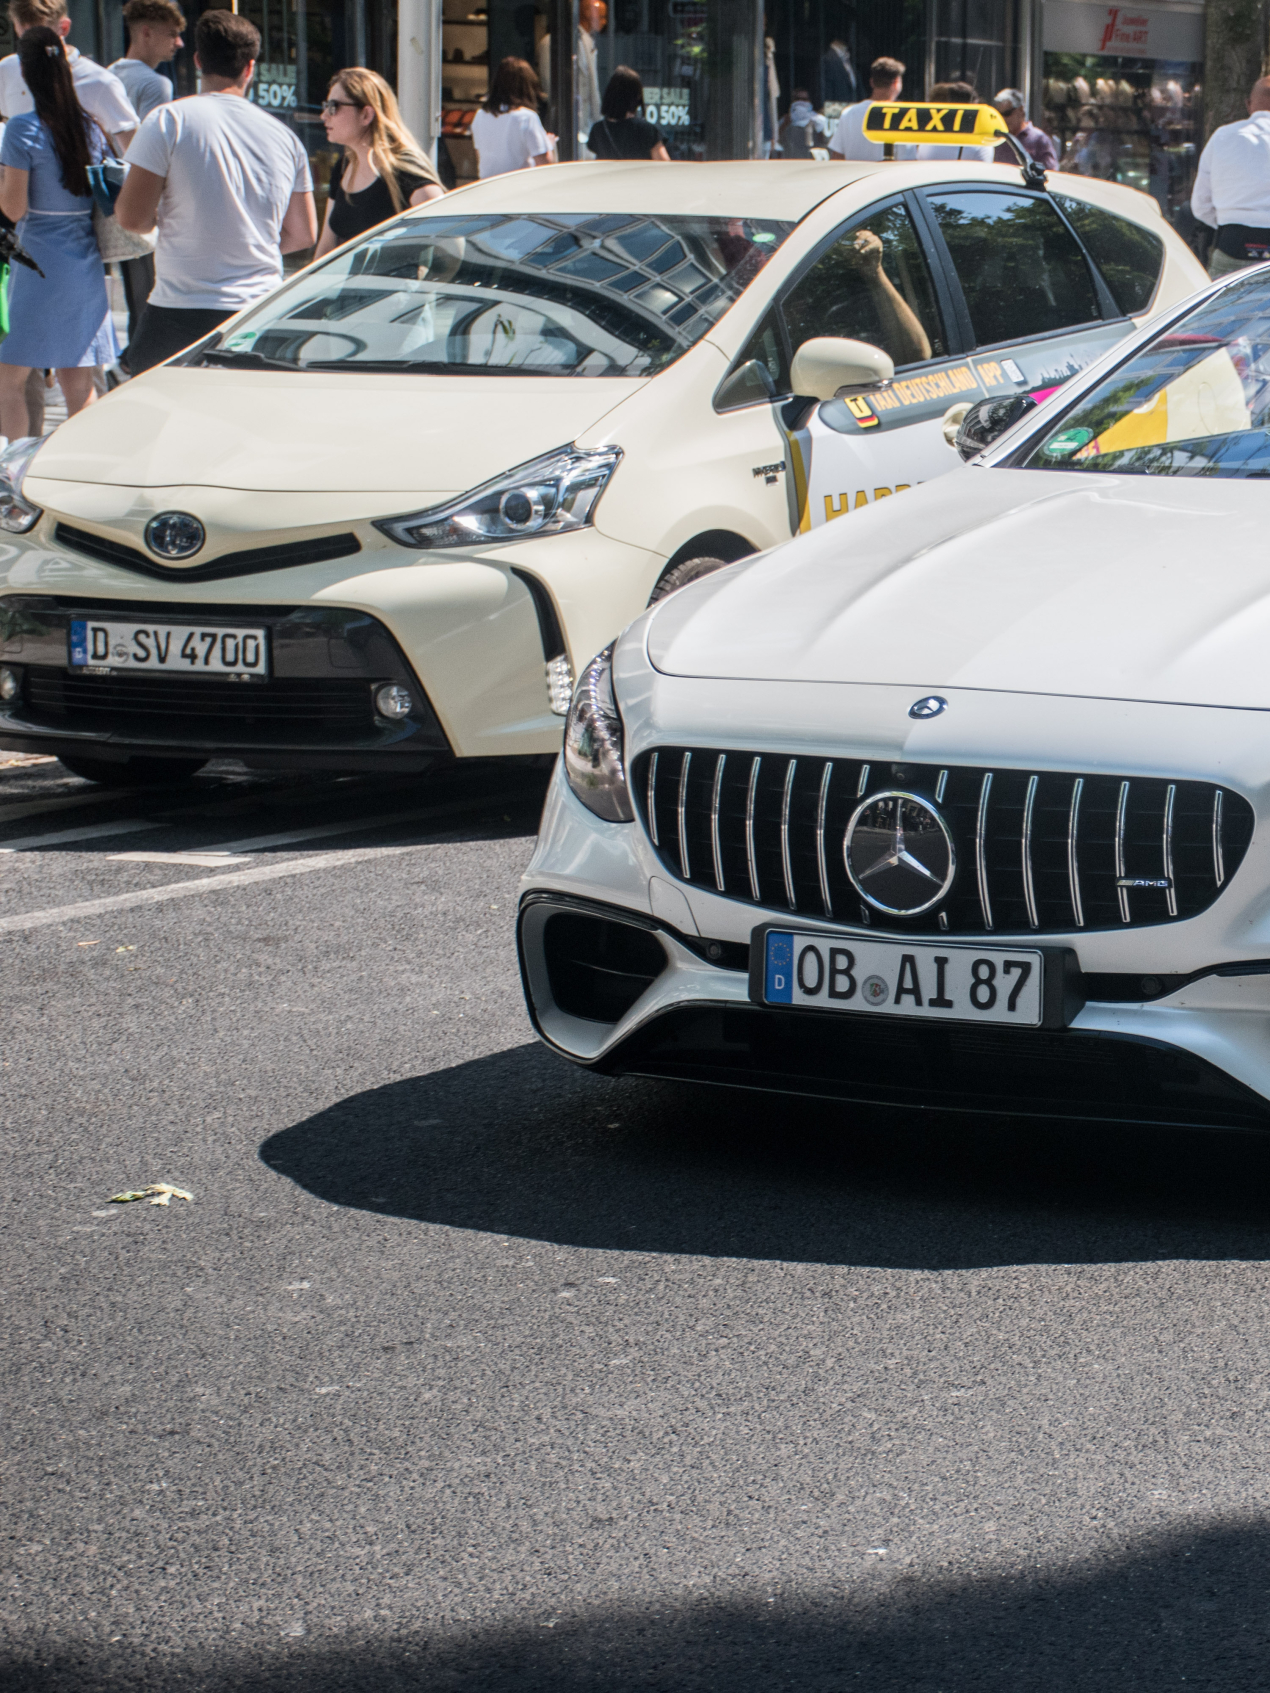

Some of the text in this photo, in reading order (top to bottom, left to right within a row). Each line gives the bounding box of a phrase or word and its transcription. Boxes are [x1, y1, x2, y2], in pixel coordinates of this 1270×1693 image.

[260, 63, 297, 84] SALE
[258, 83, 298, 107] 50%
[661, 88, 690, 104] SALE
[660, 105, 690, 125] 50%
[882, 107, 964, 131] TAXI
[869, 361, 1005, 411] TAXI DEUTSCHLAND APP
[91, 627, 260, 667] D SV 4700
[774, 973, 785, 990] D
[797, 944, 1032, 1012] OB AI 87
